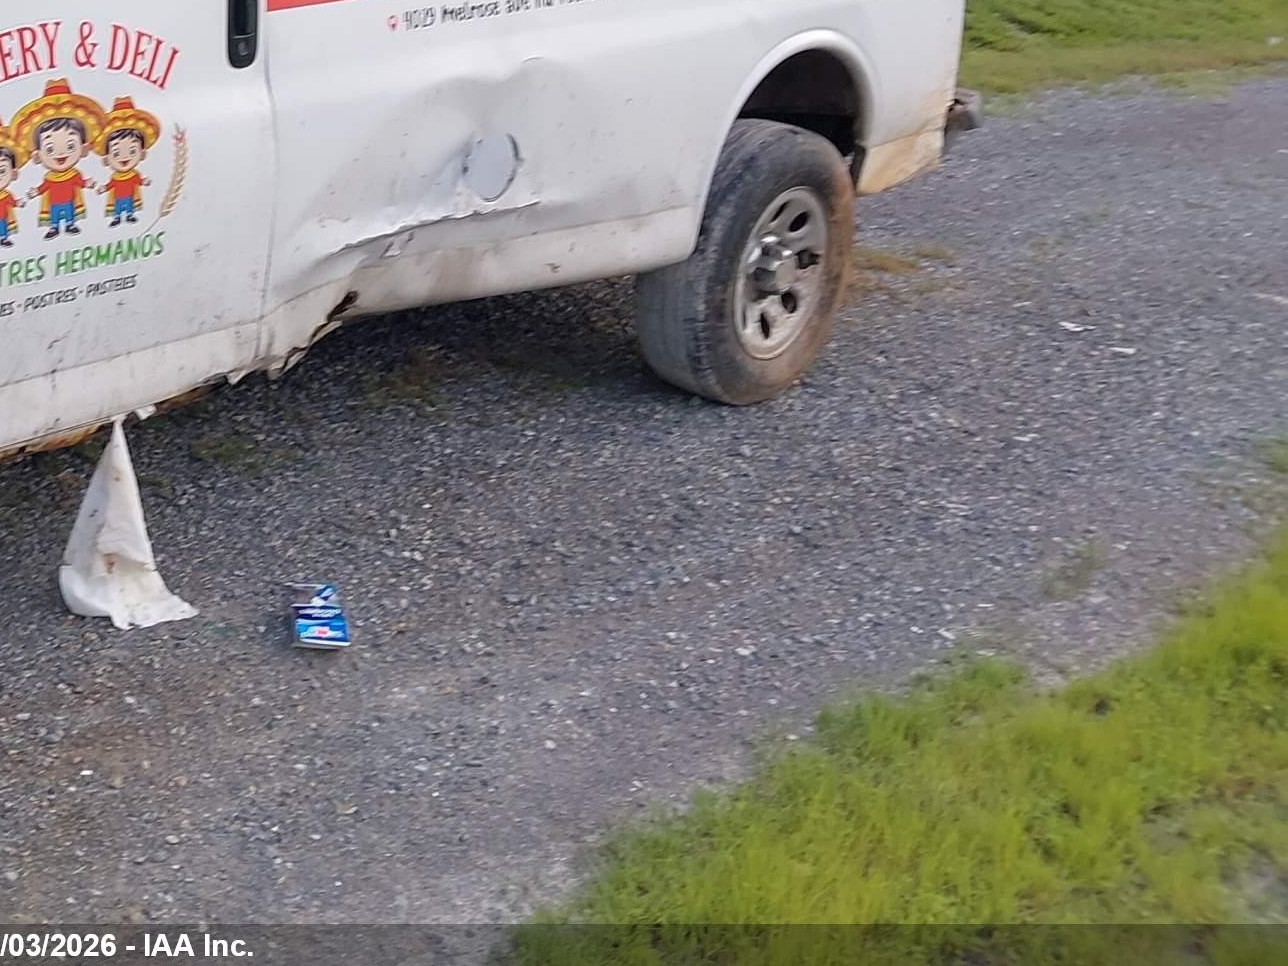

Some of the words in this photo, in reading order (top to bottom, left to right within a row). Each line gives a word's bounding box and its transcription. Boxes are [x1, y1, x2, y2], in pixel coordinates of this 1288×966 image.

[74, 20, 98, 68] &
[107, 23, 180, 90] DELI
[55, 232, 165, 276] HERMANOS
